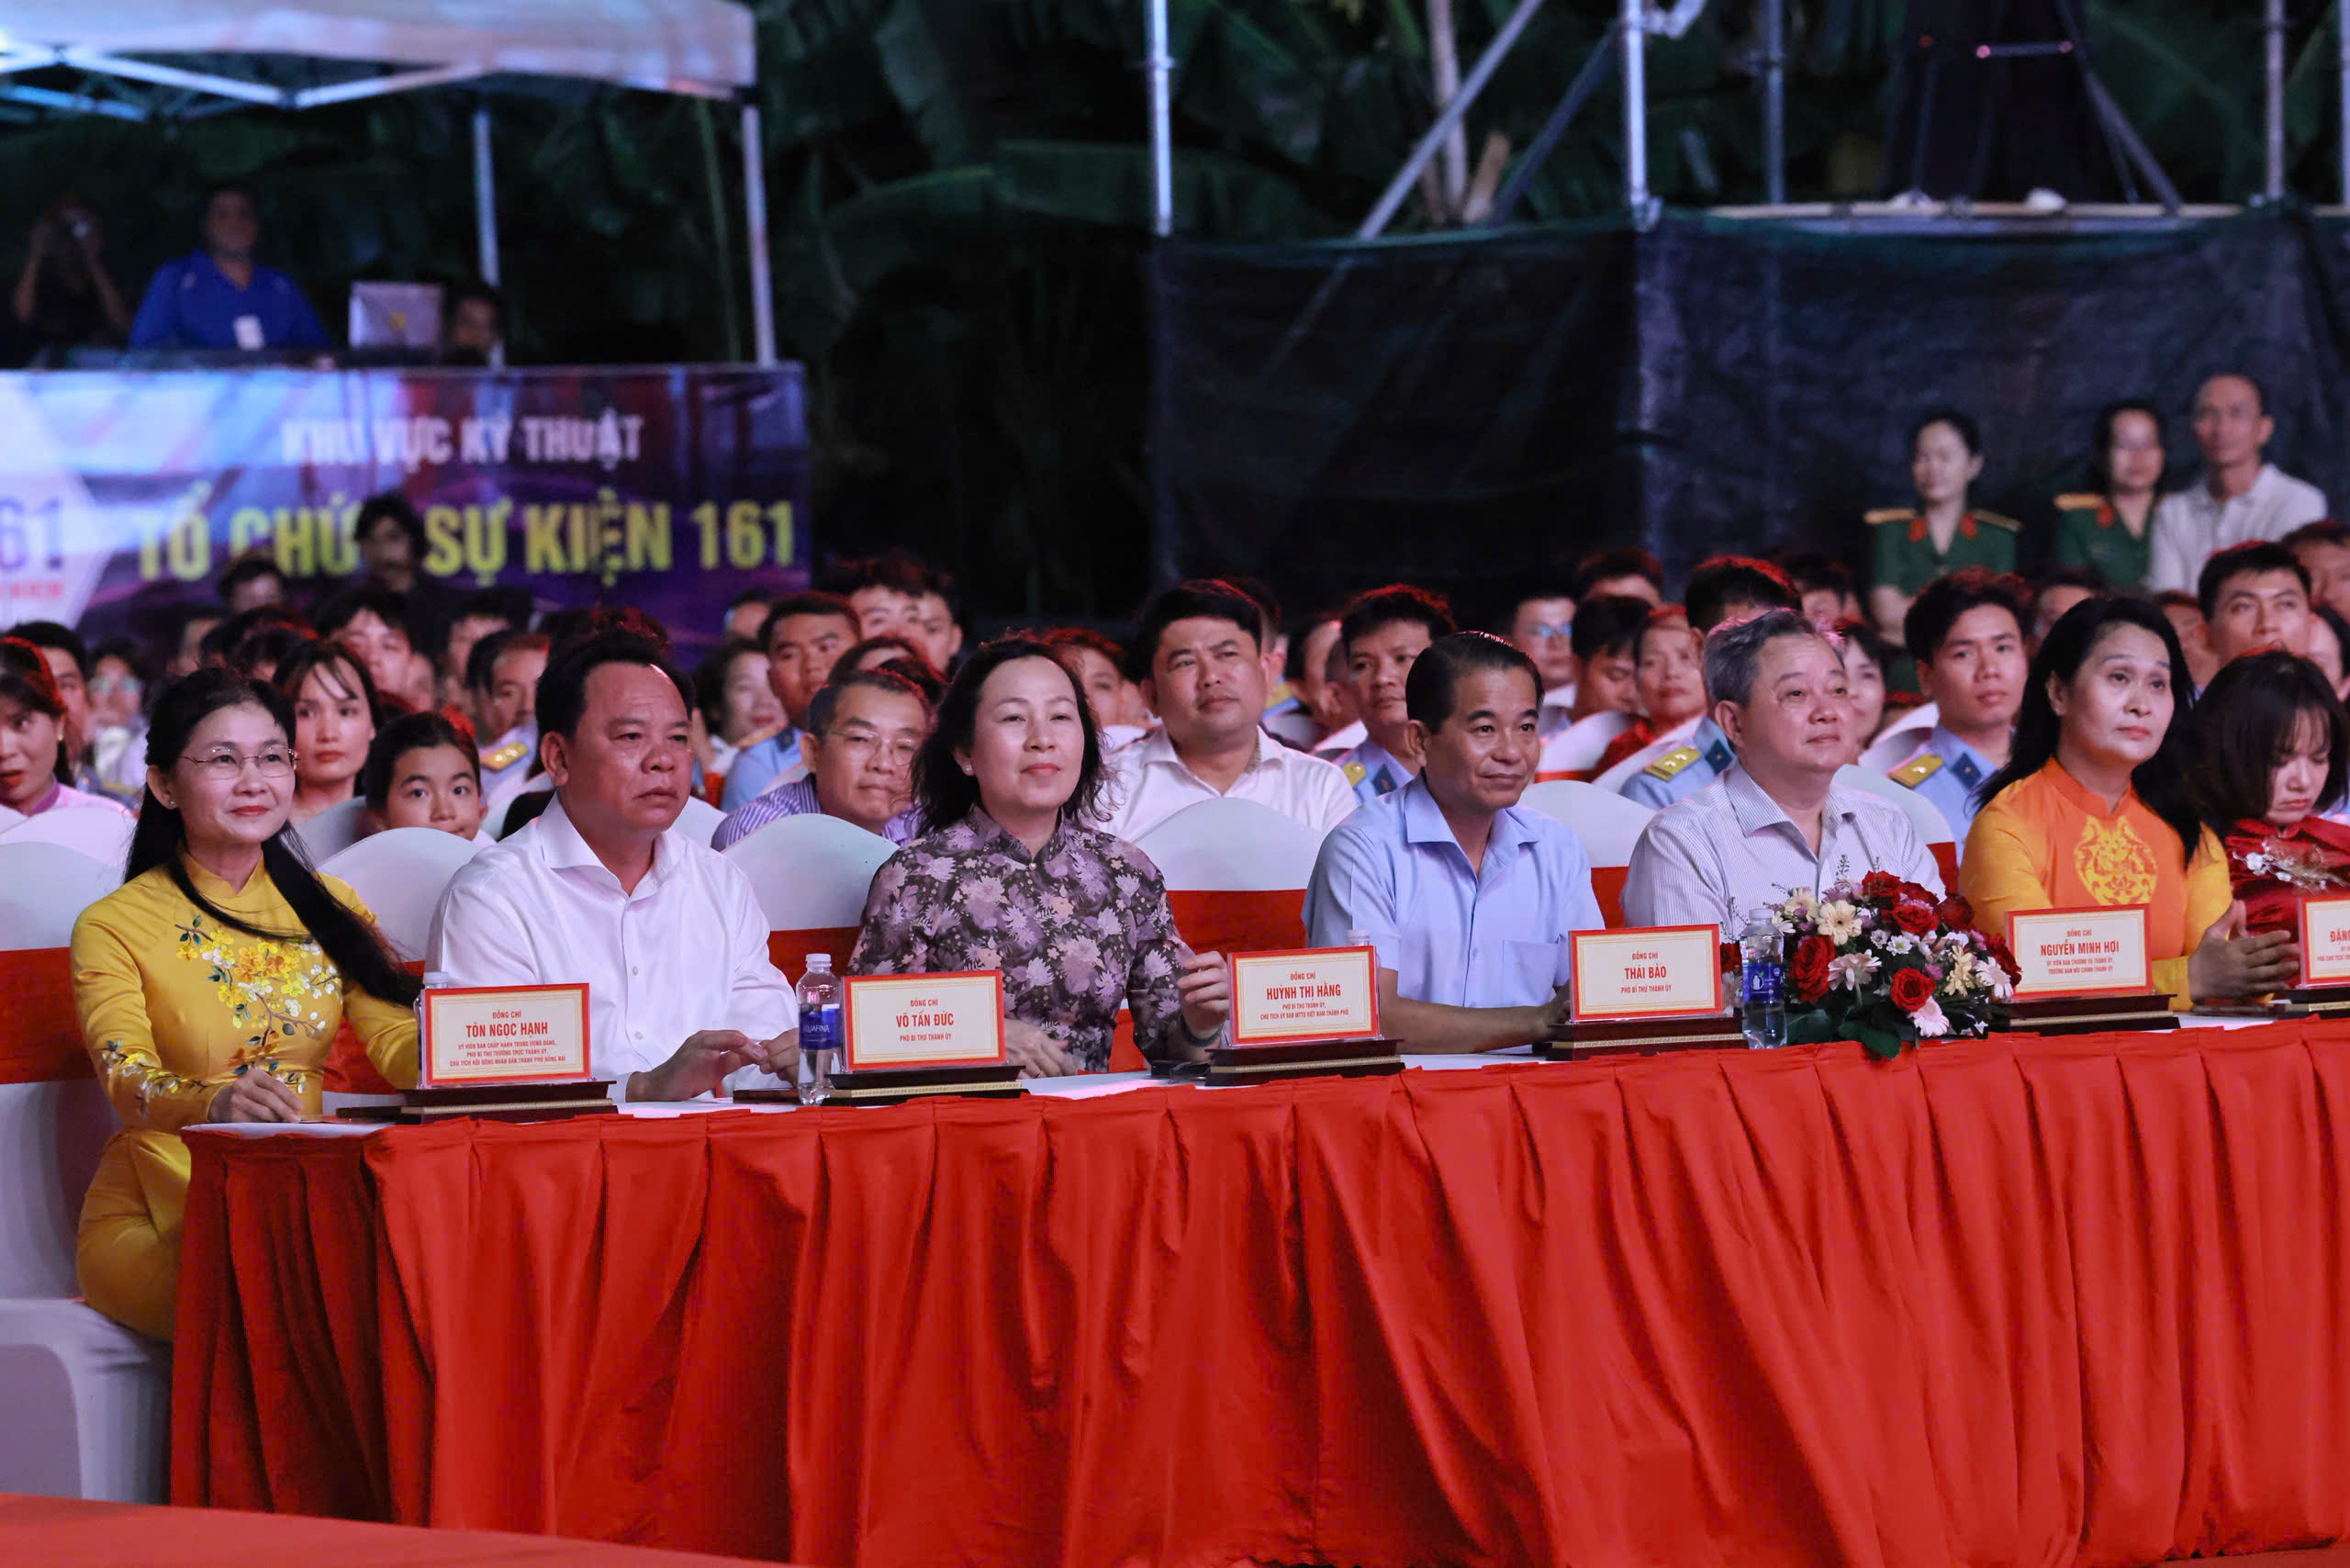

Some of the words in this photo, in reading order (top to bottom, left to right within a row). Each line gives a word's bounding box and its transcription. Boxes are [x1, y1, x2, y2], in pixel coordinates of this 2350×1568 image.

[281, 416, 368, 465] KHU
[374, 413, 453, 474] VỰC
[520, 407, 643, 472] THUẬT
[133, 480, 212, 581] TỔ
[229, 493, 364, 578] CHỨ
[423, 495, 513, 588] SỰ
[523, 487, 673, 588] KIỆN
[691, 499, 795, 570] 161
[2067, 929, 2081, 937] ĐỒNG
[1632, 951, 1647, 960] ĐỒNG
[1648, 951, 1658, 959] CHÍ
[2041, 939, 2075, 956] NGUYỄN
[2078, 942, 2101, 954] MINH
[2104, 940, 2119, 955] HỢI
[1290, 971, 1305, 980] ĐỒNG
[1625, 964, 1645, 980] THÁI
[1649, 963, 1667, 978] BẢO
[1266, 984, 1297, 1000] HUỲNH
[1299, 985, 1314, 1001] THỊ
[1317, 980, 1341, 997] HẰNG
[910, 998, 926, 1007] ĐỒNG
[928, 998, 938, 1006] CHÍ
[492, 1009, 509, 1019] ĐỒNG
[511, 1010, 521, 1019] CHÍ
[896, 1012, 909, 1028] VÕ
[912, 1010, 930, 1027] TẤN
[934, 1010, 954, 1026] ĐỨC
[466, 1021, 485, 1037] TÔN
[489, 1023, 517, 1038] NGỌC
[521, 1021, 548, 1037] HẠNH
